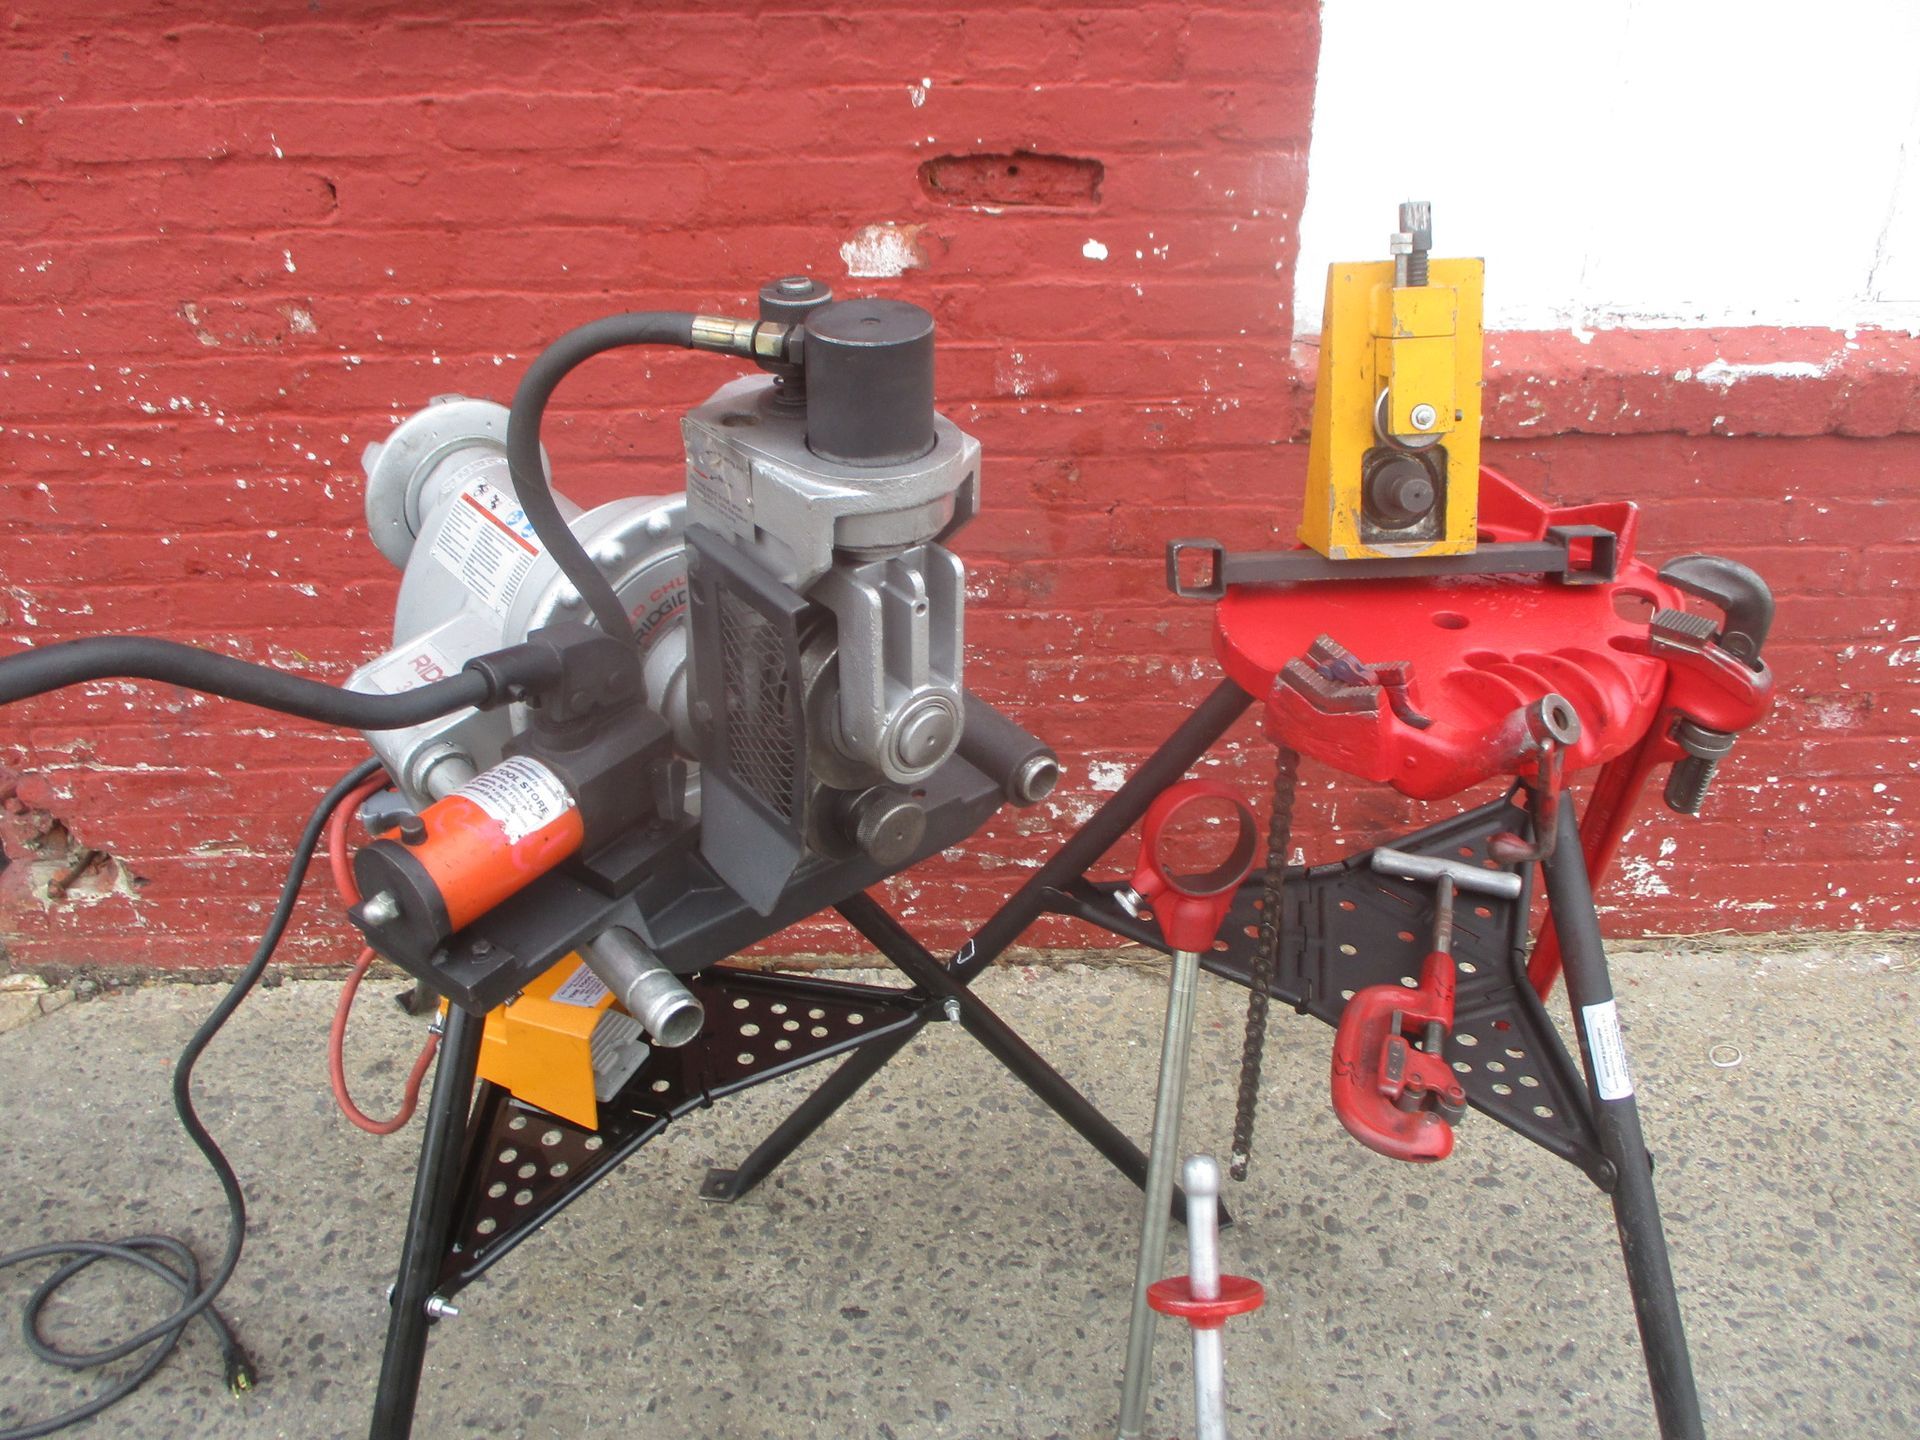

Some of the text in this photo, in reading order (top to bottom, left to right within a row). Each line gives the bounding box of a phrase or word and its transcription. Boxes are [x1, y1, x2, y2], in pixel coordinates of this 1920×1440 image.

[408, 654, 449, 684] RID
[496, 768, 520, 783] TOOL
[520, 781, 550, 815] STORE
